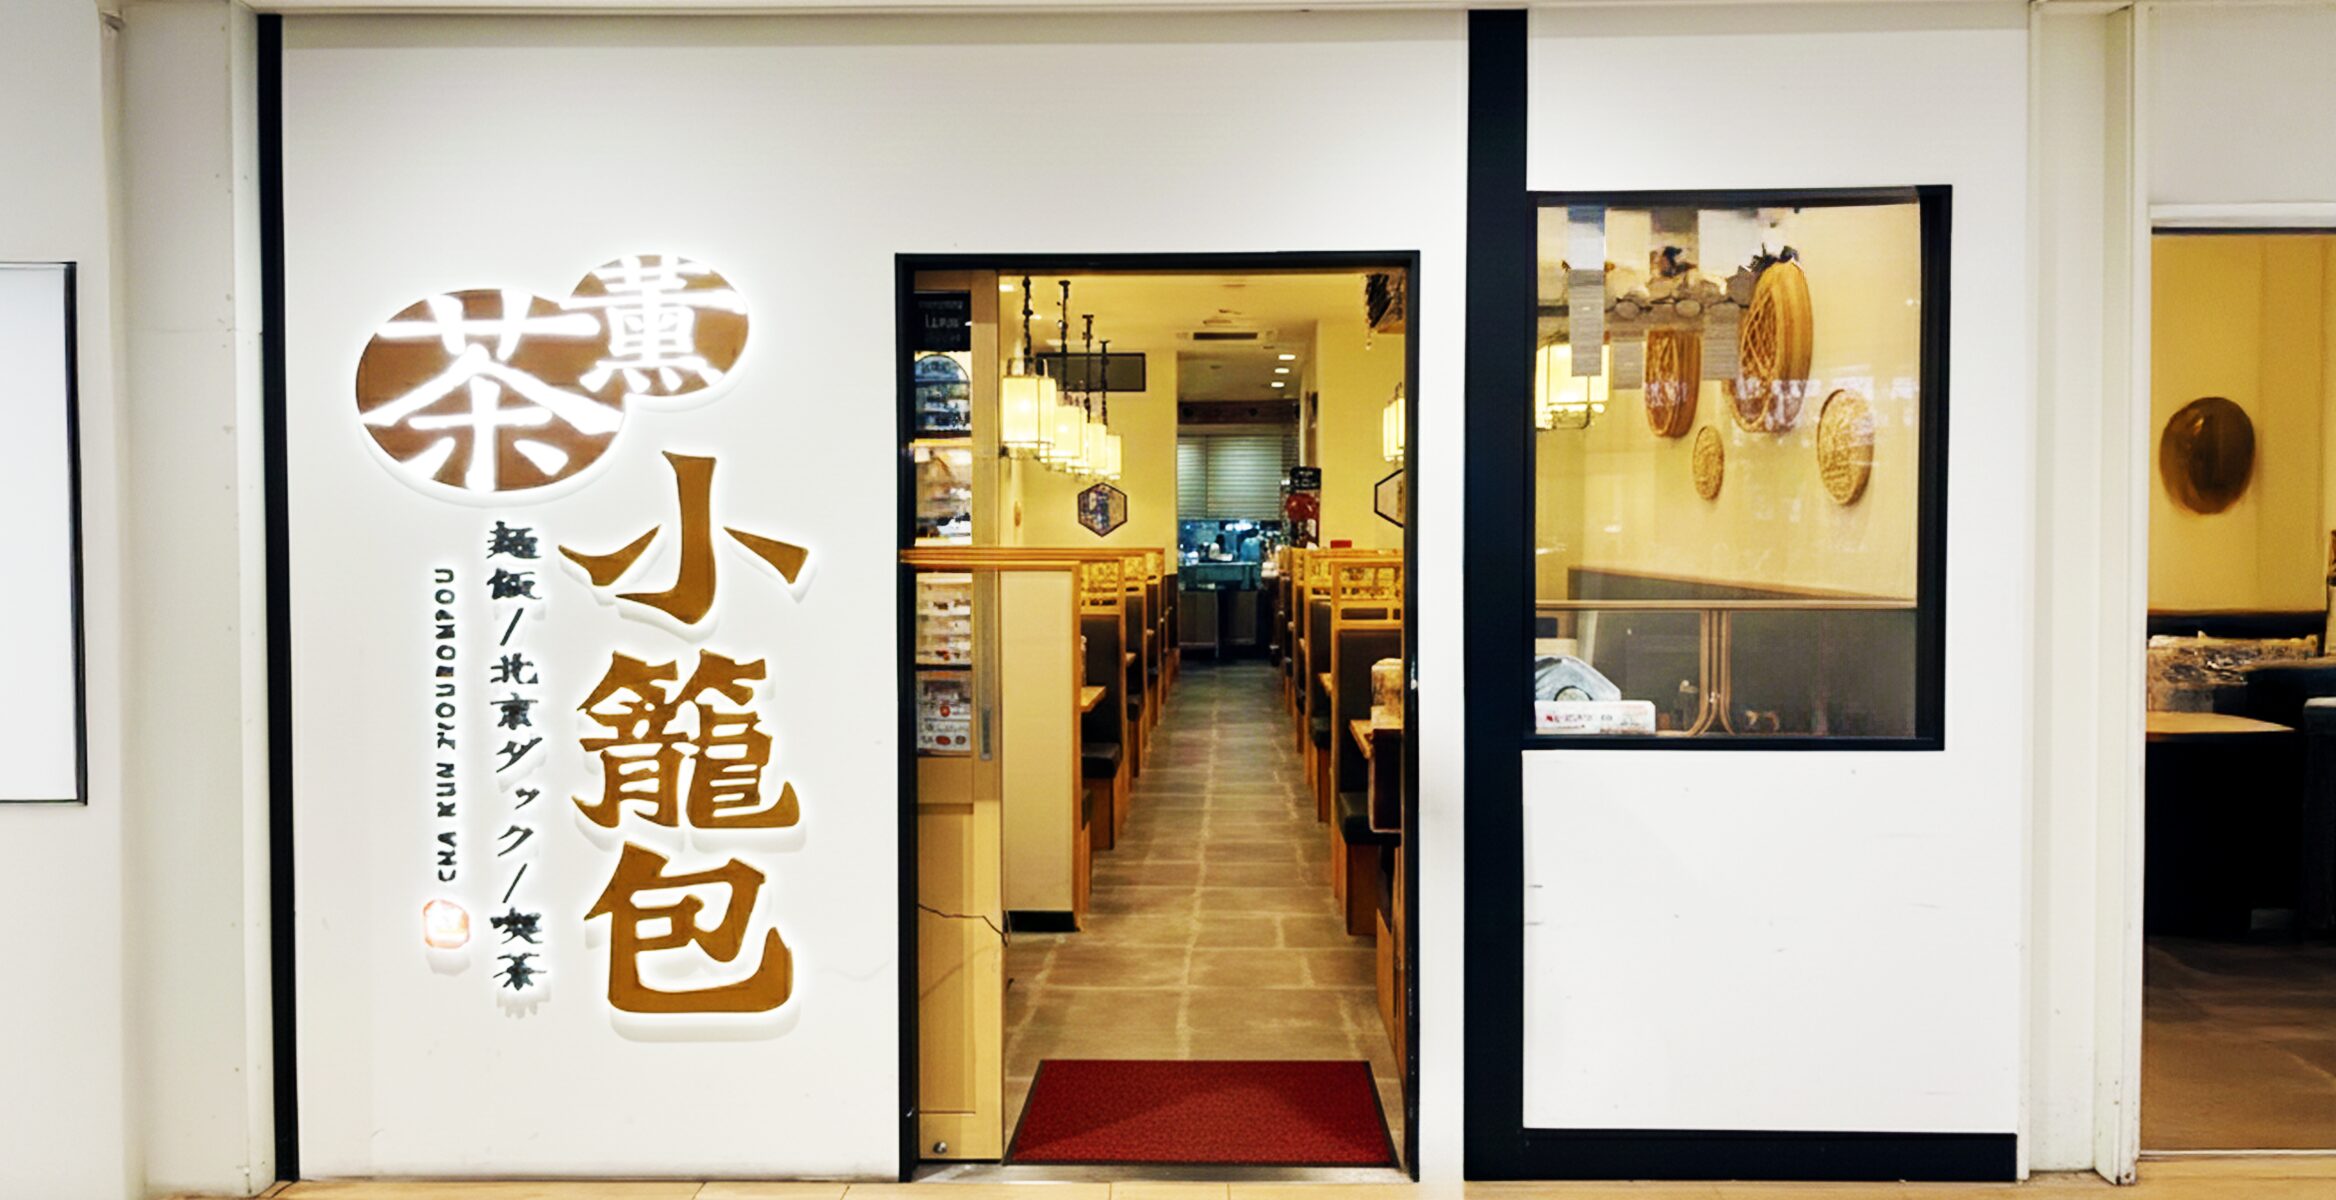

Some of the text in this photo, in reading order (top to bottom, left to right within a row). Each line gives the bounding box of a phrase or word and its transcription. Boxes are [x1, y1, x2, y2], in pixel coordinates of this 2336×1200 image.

[360, 294, 625, 492] 茶
[436, 762, 456, 818] KUN
[558, 450, 809, 1014] 小籠包
[437, 831, 457, 882] CHA
